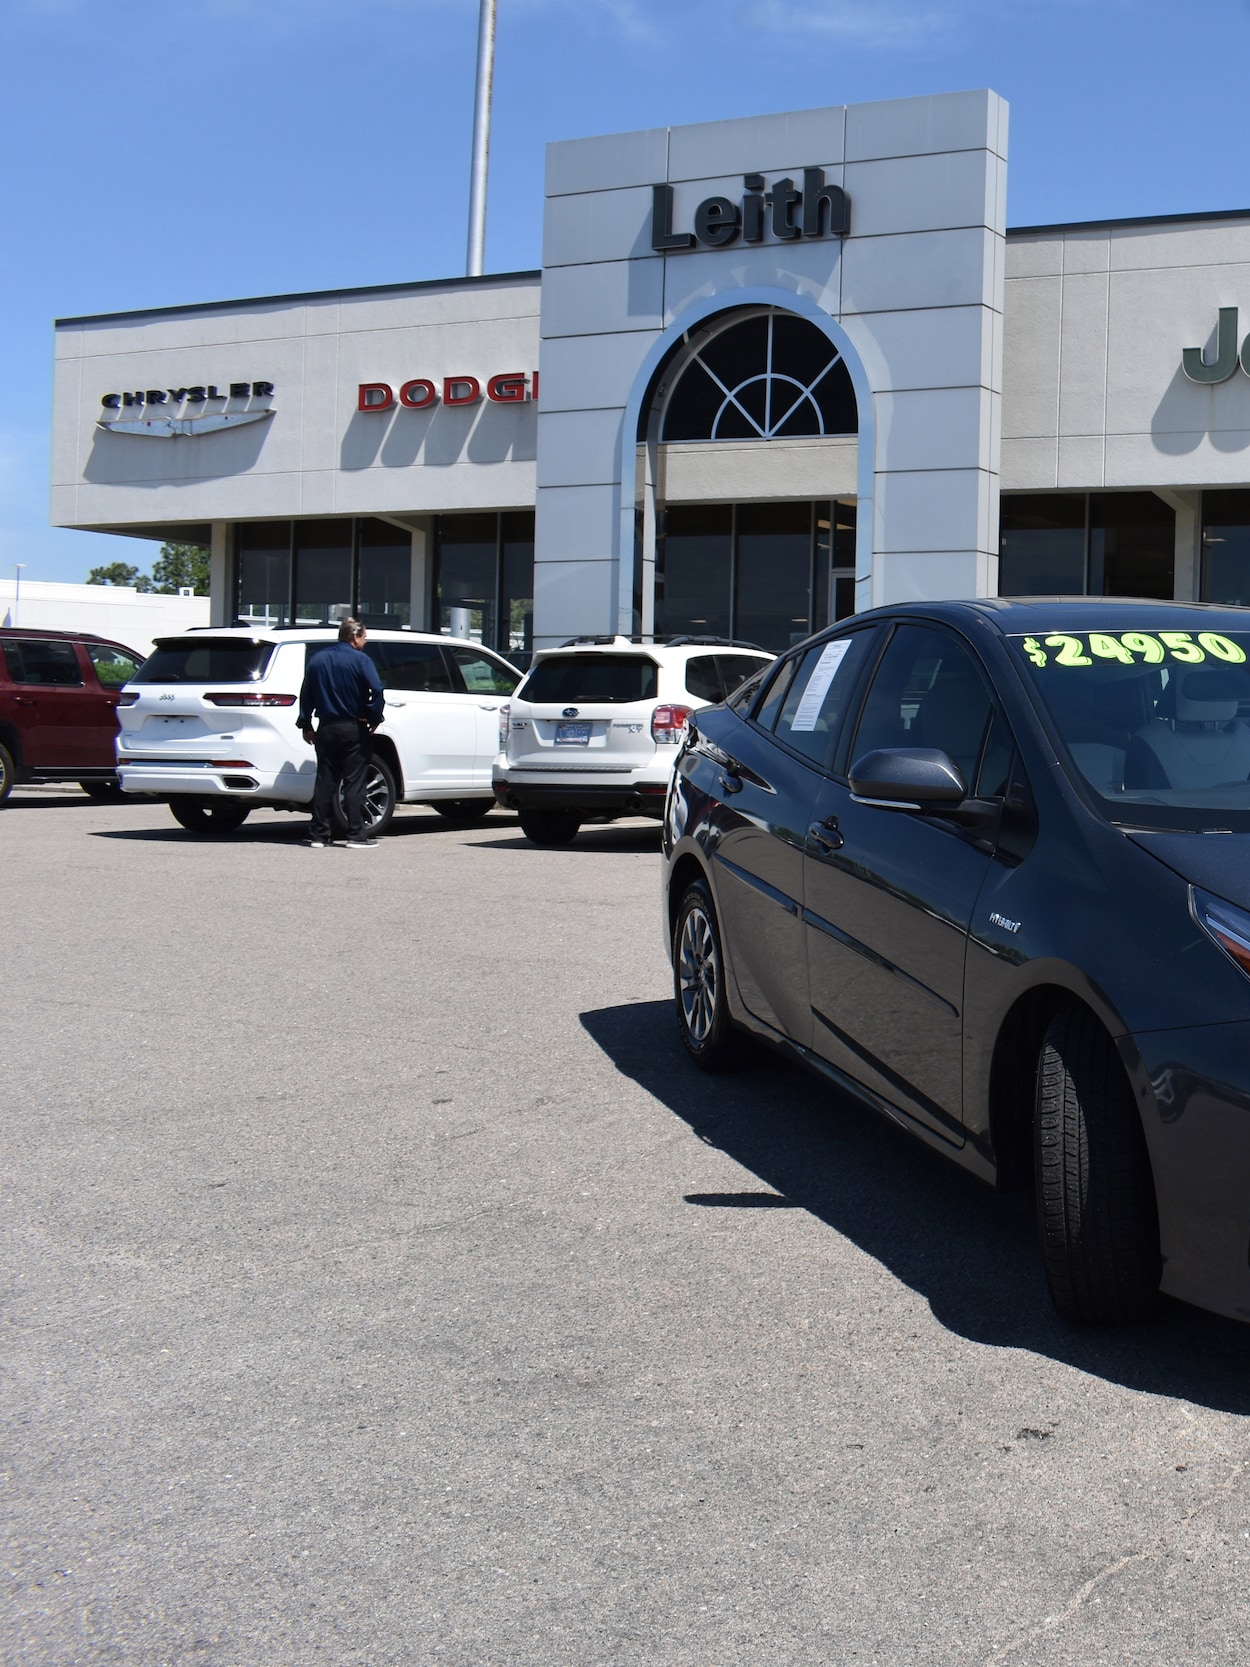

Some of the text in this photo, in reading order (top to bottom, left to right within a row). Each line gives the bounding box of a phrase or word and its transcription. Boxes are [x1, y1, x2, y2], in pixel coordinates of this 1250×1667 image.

[652, 167, 851, 251] Leith
[101, 381, 275, 409] CHRYSLER
[358, 371, 539, 412] DODG
[1023, 632, 1247, 668] $24950
